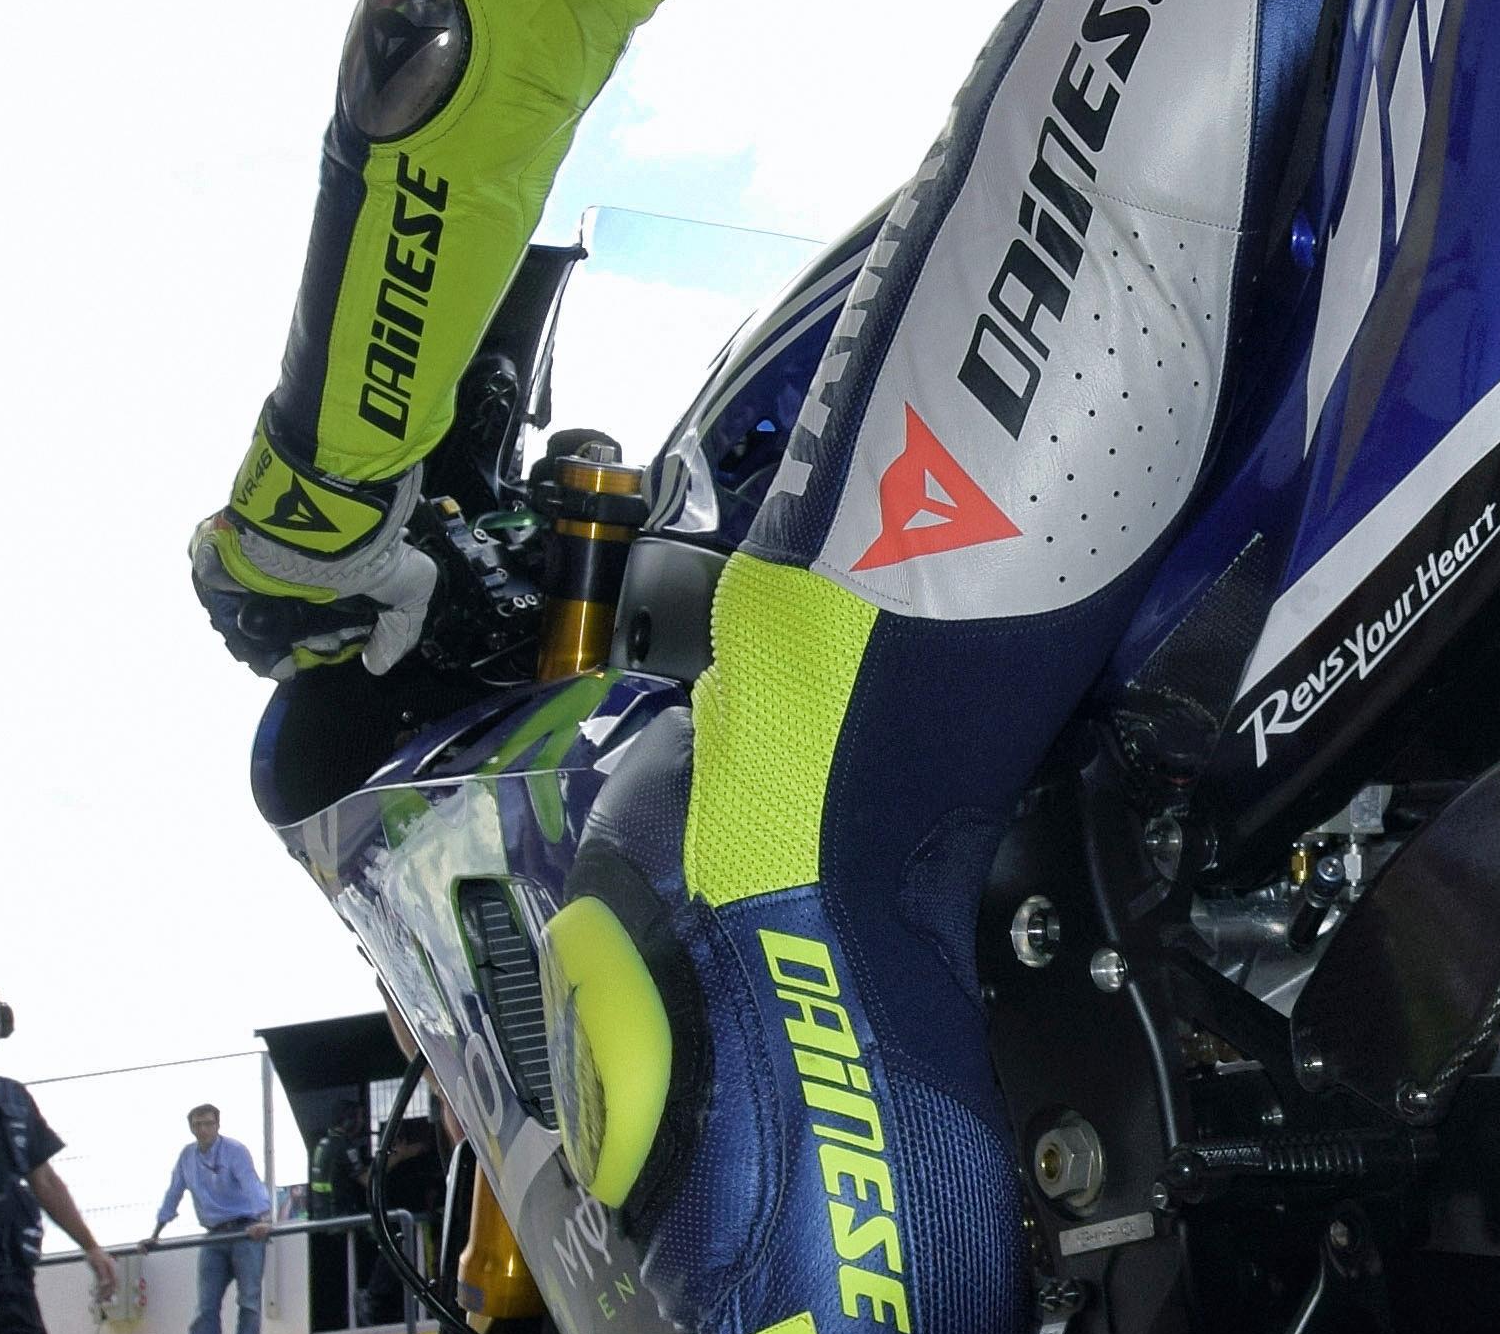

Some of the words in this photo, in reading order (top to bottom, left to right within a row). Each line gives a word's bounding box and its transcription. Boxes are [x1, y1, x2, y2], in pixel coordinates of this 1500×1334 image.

[1237, 646, 1345, 768] Revs
[1343, 583, 1415, 681] Your
[1415, 502, 1498, 601] Heart
